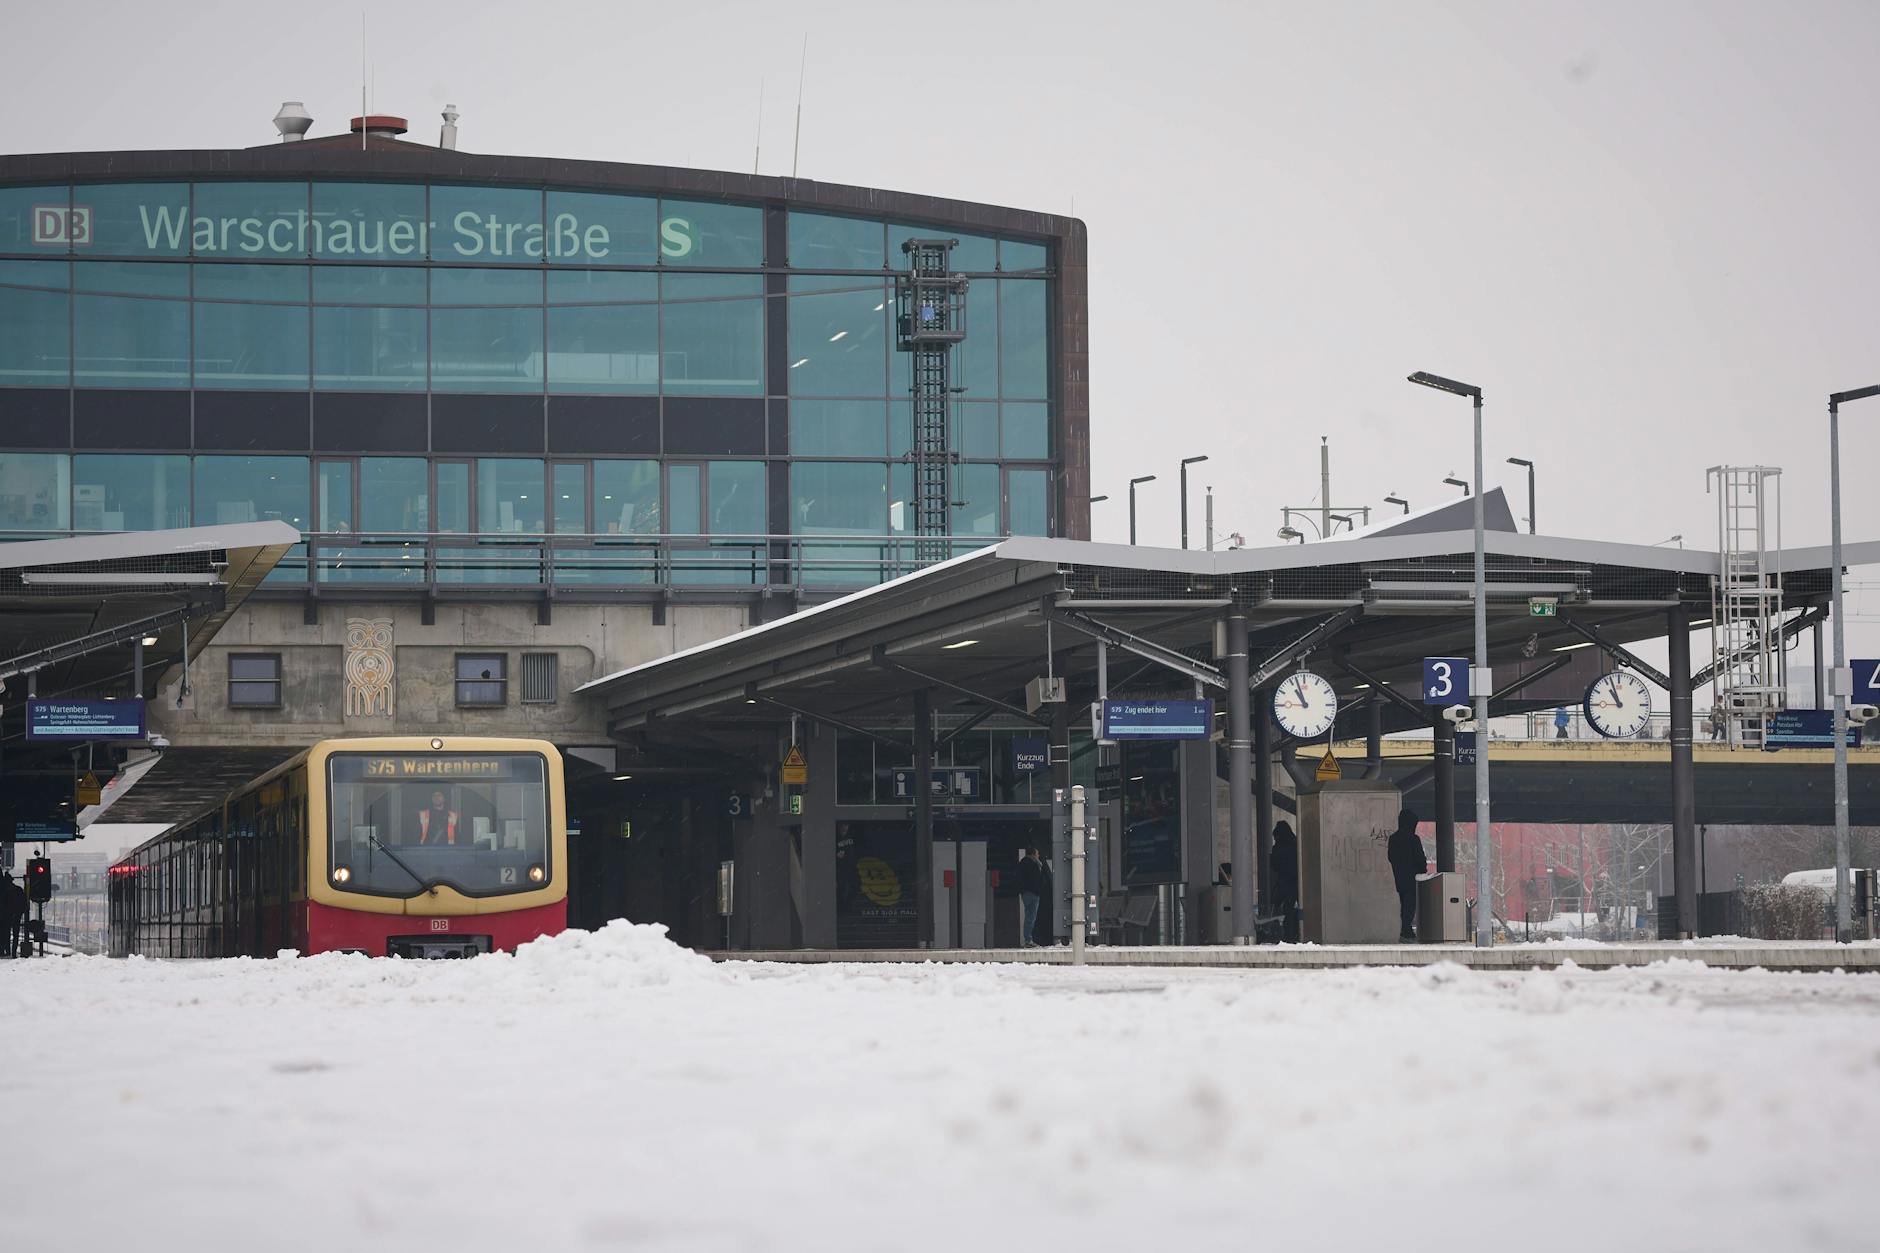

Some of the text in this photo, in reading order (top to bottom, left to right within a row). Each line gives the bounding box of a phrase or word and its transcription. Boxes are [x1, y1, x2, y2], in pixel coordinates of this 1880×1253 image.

[37, 209, 87, 241] DB
[139, 205, 611, 258] Warschauer Straße
[660, 217, 692, 257] S
[1431, 661, 1453, 697] 3
[50, 705, 89, 715] Wartenberg
[1124, 706, 1136, 715] Zug
[1137, 706, 1154, 714] endet
[1155, 706, 1167, 714] hier
[1017, 754, 1044, 763] Kurzzug
[1017, 761, 1035, 769] Ende
[367, 758, 499, 775] S75 Wartenberg
[728, 795, 742, 815] 3
[504, 868, 513, 882] 2
[432, 920, 448, 930] DB
